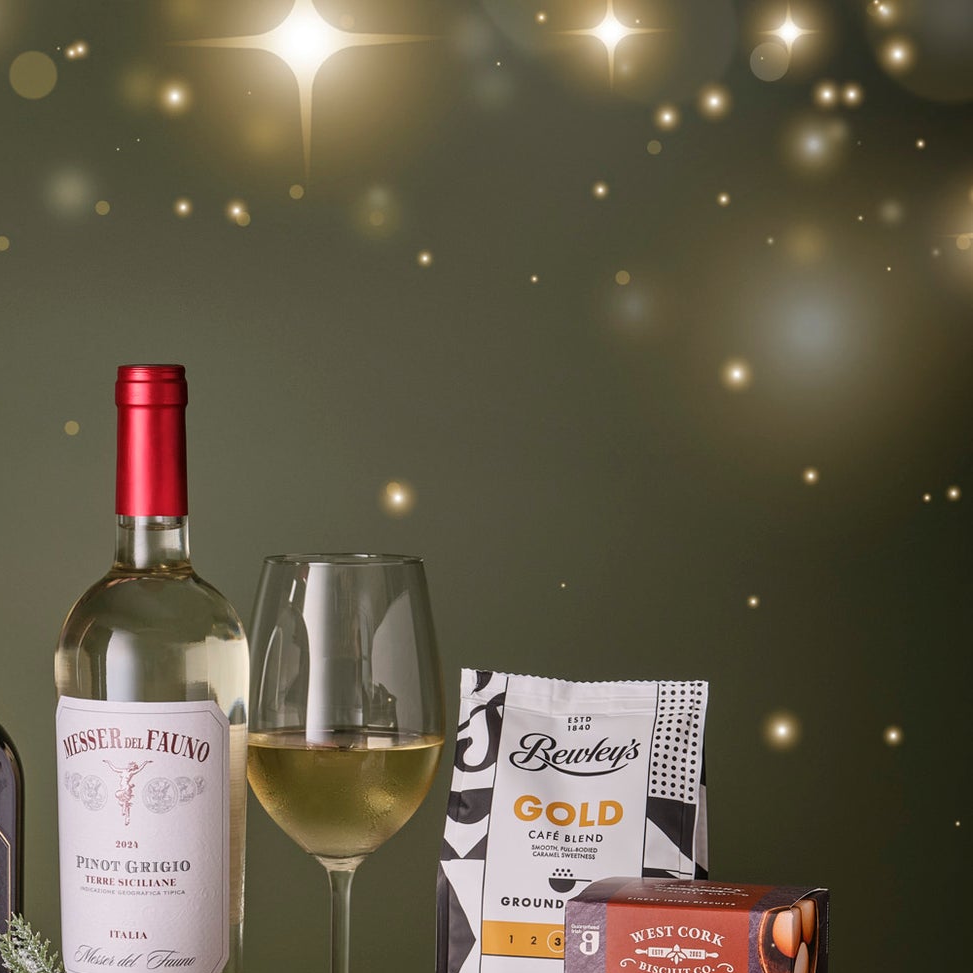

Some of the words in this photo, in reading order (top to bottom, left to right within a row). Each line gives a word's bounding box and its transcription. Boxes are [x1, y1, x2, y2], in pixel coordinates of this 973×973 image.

[567, 716, 592, 724] ESTD
[567, 724, 591, 732] 1840
[63, 727, 122, 759] MESSER
[124, 737, 144, 750] DEL
[146, 729, 210, 763] FAUNO
[509, 732, 641, 777] Bewley's
[513, 795, 624, 828] GOLD
[528, 830, 559, 841] CAFÉ
[564, 833, 604, 843] BLEND
[115, 840, 139, 849] 2024
[532, 851, 560, 859] CARAMEL
[561, 852, 596, 860] SWEETNESS
[76, 855, 121, 872] PINOT
[125, 860, 191, 874] GRIGIO
[85, 875, 115, 886] TERRE
[118, 878, 177, 887] SICILIANE
[501, 896, 564, 909] GROUND
[109, 930, 148, 939] ITALIA
[509, 934, 514, 944] 1
[531, 936, 537, 945] 2
[629, 925, 675, 944] WEST
[678, 926, 726, 947] CORK
[554, 937, 562, 946] 3
[74, 944, 115, 966] Messer
[116, 953, 143, 967] del
[146, 949, 197, 970] Fauno
